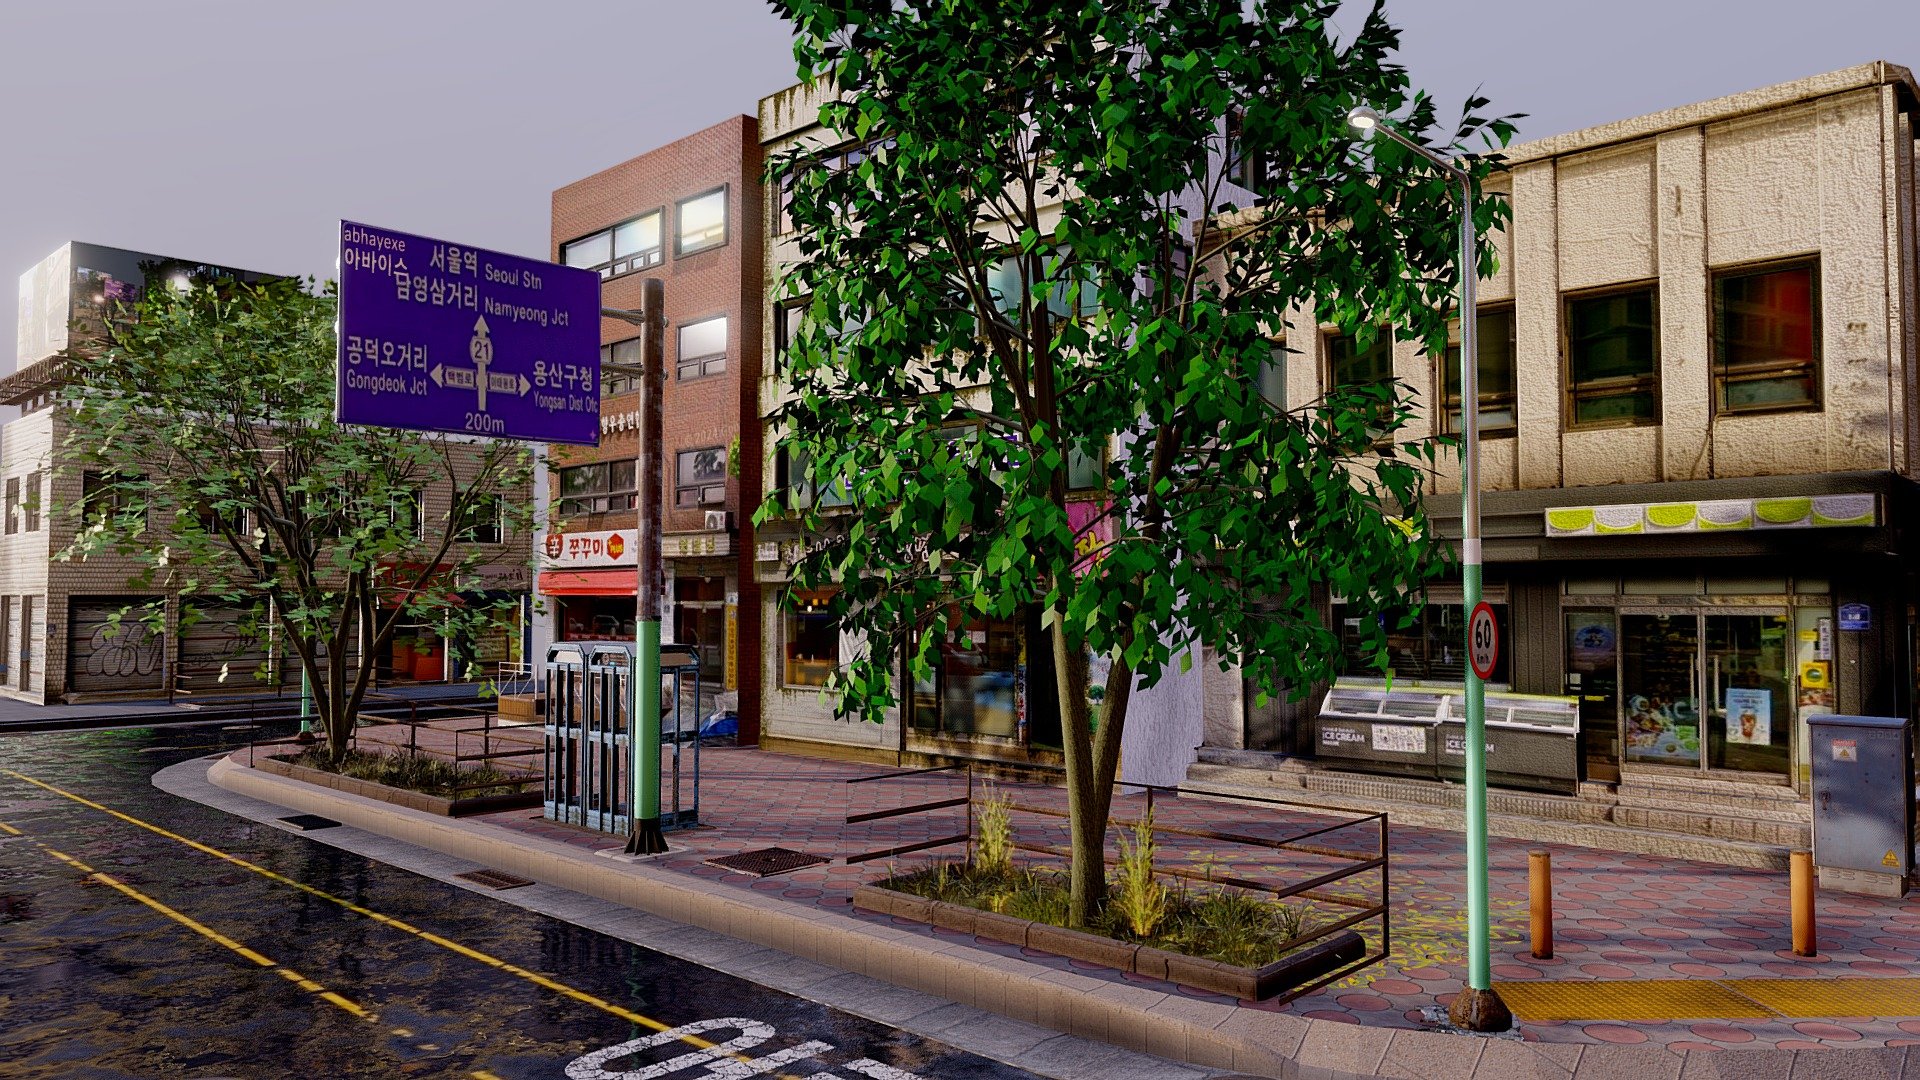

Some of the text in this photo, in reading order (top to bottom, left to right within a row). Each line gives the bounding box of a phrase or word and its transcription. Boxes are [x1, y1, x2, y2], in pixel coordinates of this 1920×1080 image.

[344, 226, 405, 252] abhayexe
[430, 245, 478, 278] 서울역
[485, 263, 542, 290] Seoul Stn
[485, 297, 569, 327] Namyeong Jct
[347, 335, 427, 373] 공덕오거리
[474, 341, 489, 360] 21
[347, 368, 428, 396] Gongdeok Jct
[533, 360, 593, 392] 용산구청
[533, 391, 566, 413] Yongsan
[569, 394, 584, 412] Dist
[465, 412, 504, 434] 200m
[1475, 619, 1491, 649] 60
[1322, 731, 1365, 743] ICE CREAM
[1446, 739, 1461, 749] ICE
